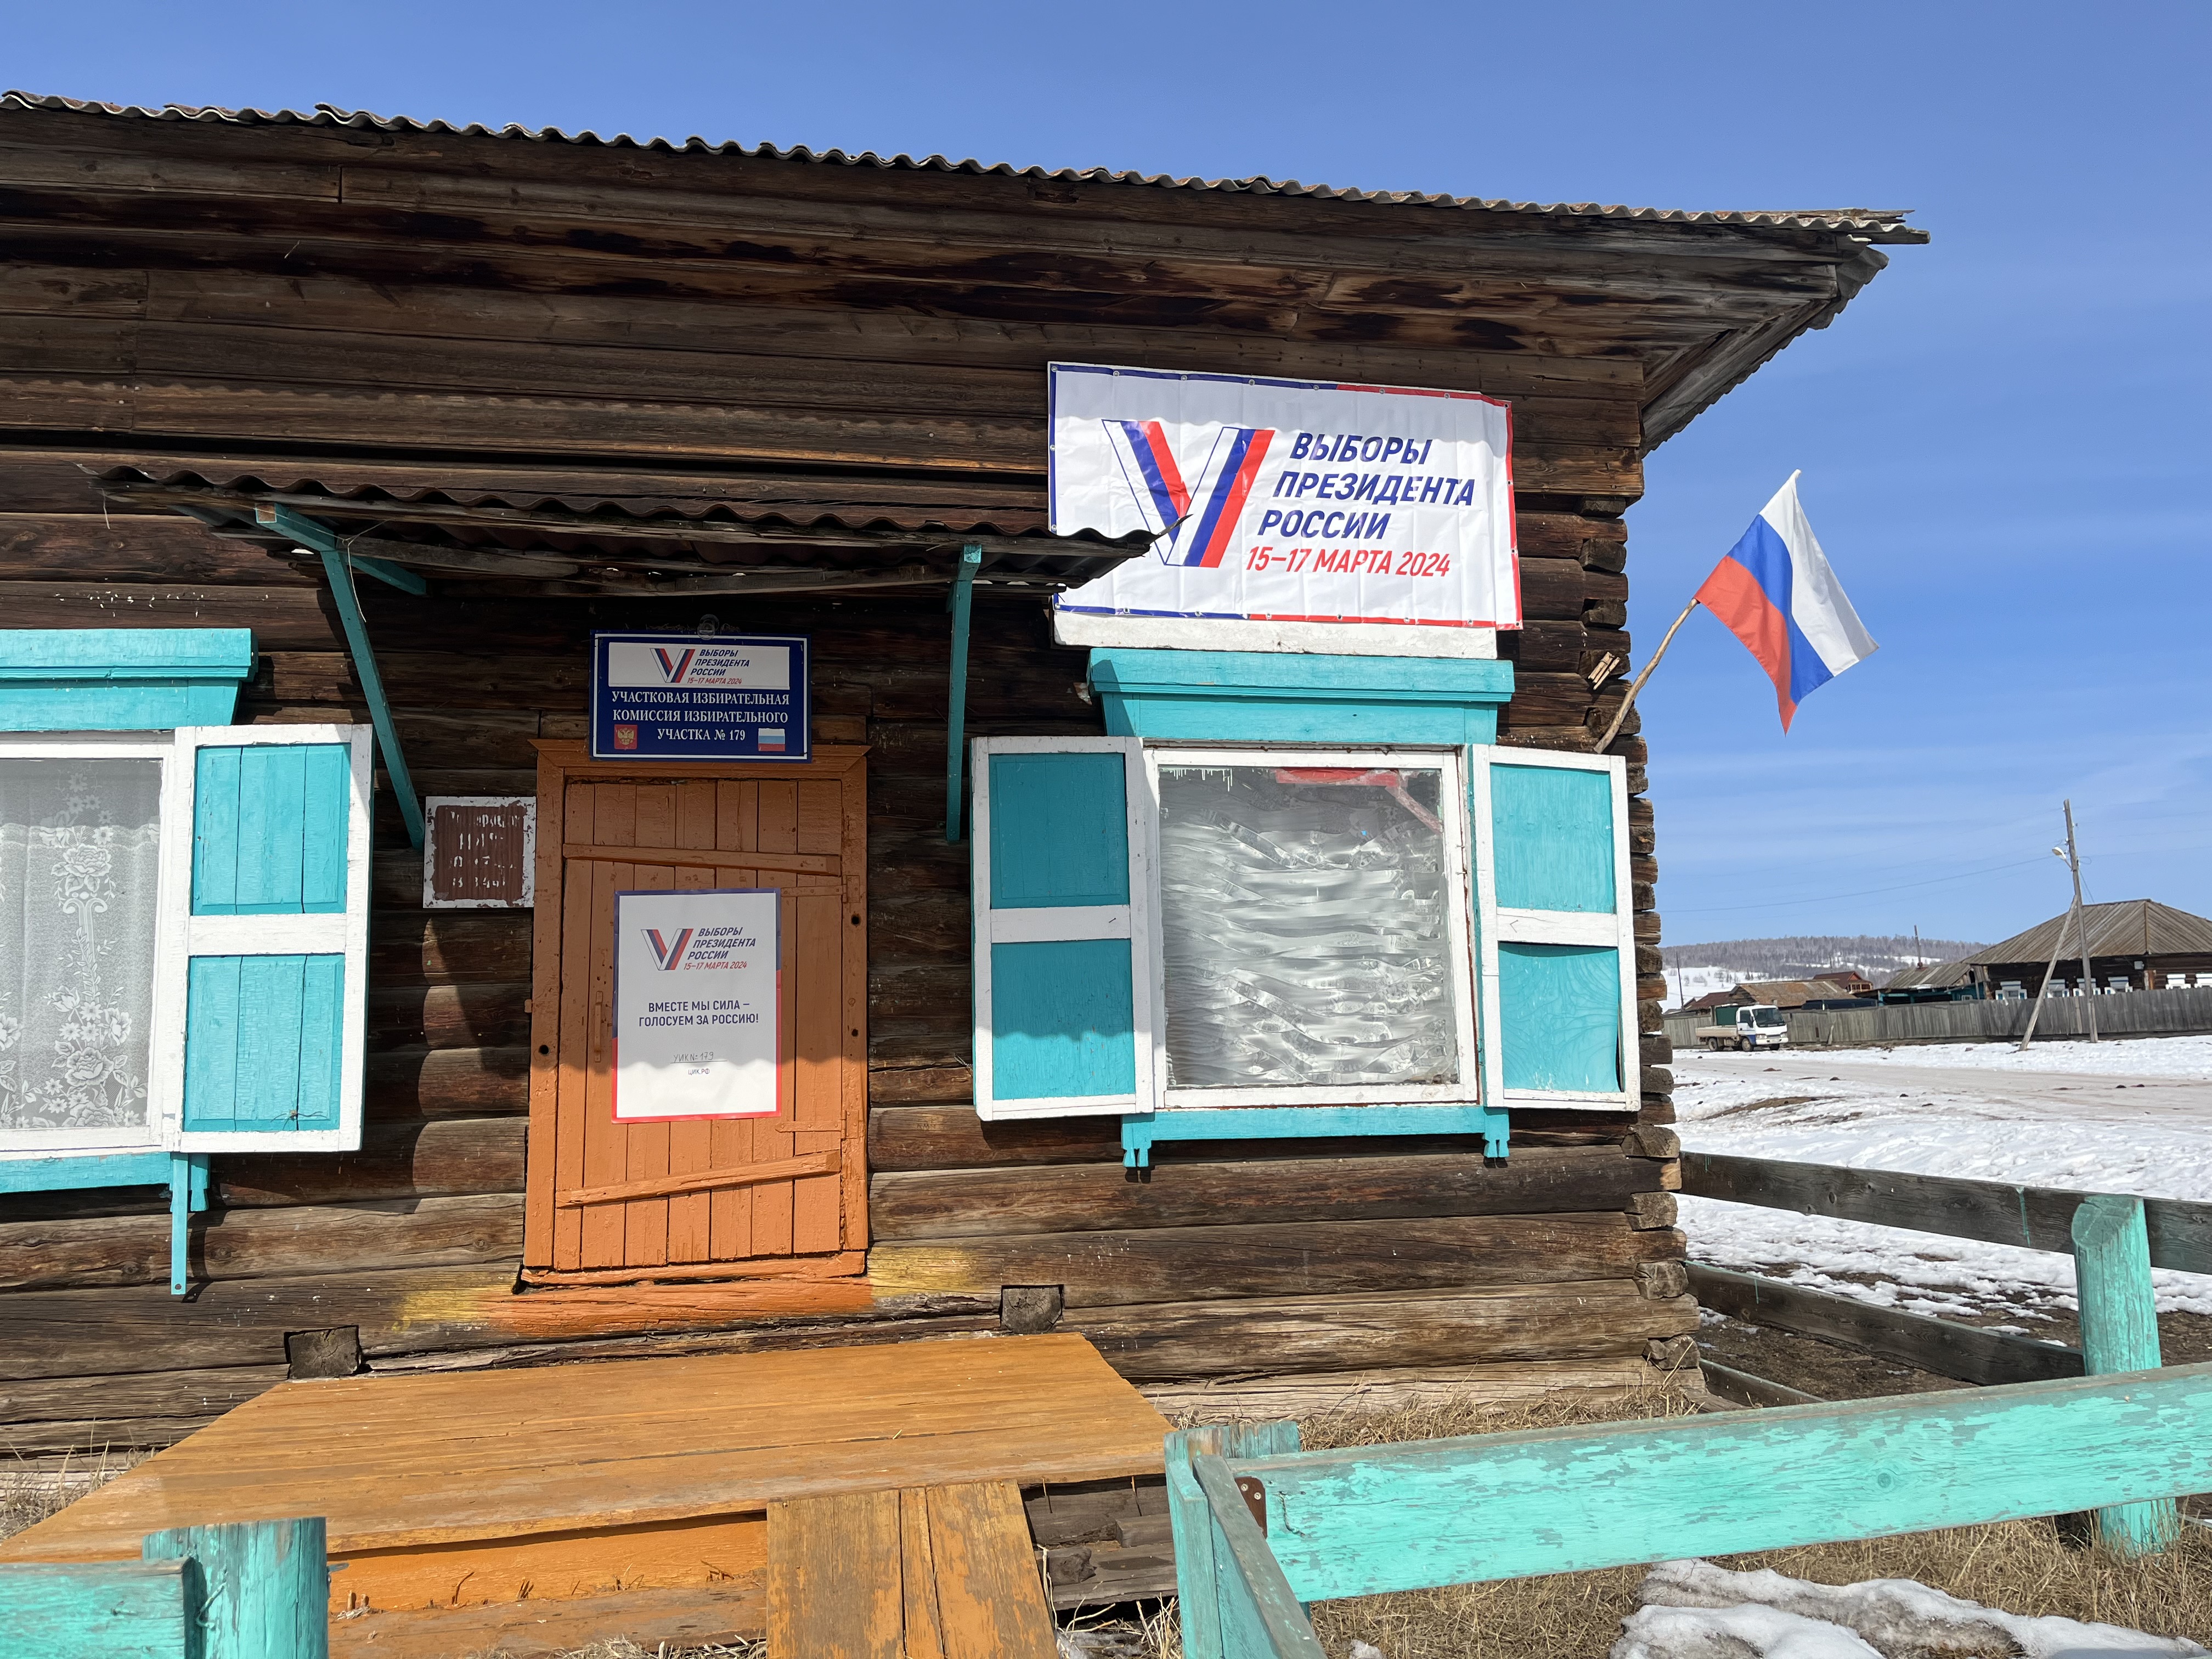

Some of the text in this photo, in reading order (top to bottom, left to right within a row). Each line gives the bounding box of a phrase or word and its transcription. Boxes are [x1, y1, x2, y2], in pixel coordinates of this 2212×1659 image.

[1289, 432, 1433, 465] ВЫБОРЫ
[1272, 471, 1475, 506] ПРЕЗИДЕНТА
[1257, 509, 1392, 540] РОССИИ
[1312, 548, 1393, 574] МАРТА
[1395, 551, 1451, 577] 2024
[699, 649, 738, 657] ВЫБОРЫ
[695, 659, 750, 667] ПРЕЗИДЕНТА
[612, 691, 789, 705] УЧАСТКОВАЯ ИЗБИРАТЕЛЬНАЯ
[613, 709, 788, 723] КОМИССИЯ ИЗБИРАТЕЛЬНОГО
[657, 729, 746, 741] УЧАСТКА № 179
[698, 927, 743, 937] ВЫБОРЫ
[692, 938, 756, 949] ПРЕЗИДЕНТА
[687, 950, 729, 960] РОССИИ
[704, 961, 729, 970] МАРТА
[730, 961, 747, 969] 2024
[648, 1001, 689, 1012] ВМЕСТЕ
[691, 1001, 710, 1011] МЫ
[713, 1000, 741, 1011] СИЛА
[639, 1013, 759, 1027] ГОЛОСУЕМ ЗА РОССИЮ!
[700, 1051, 714, 1060] 179
